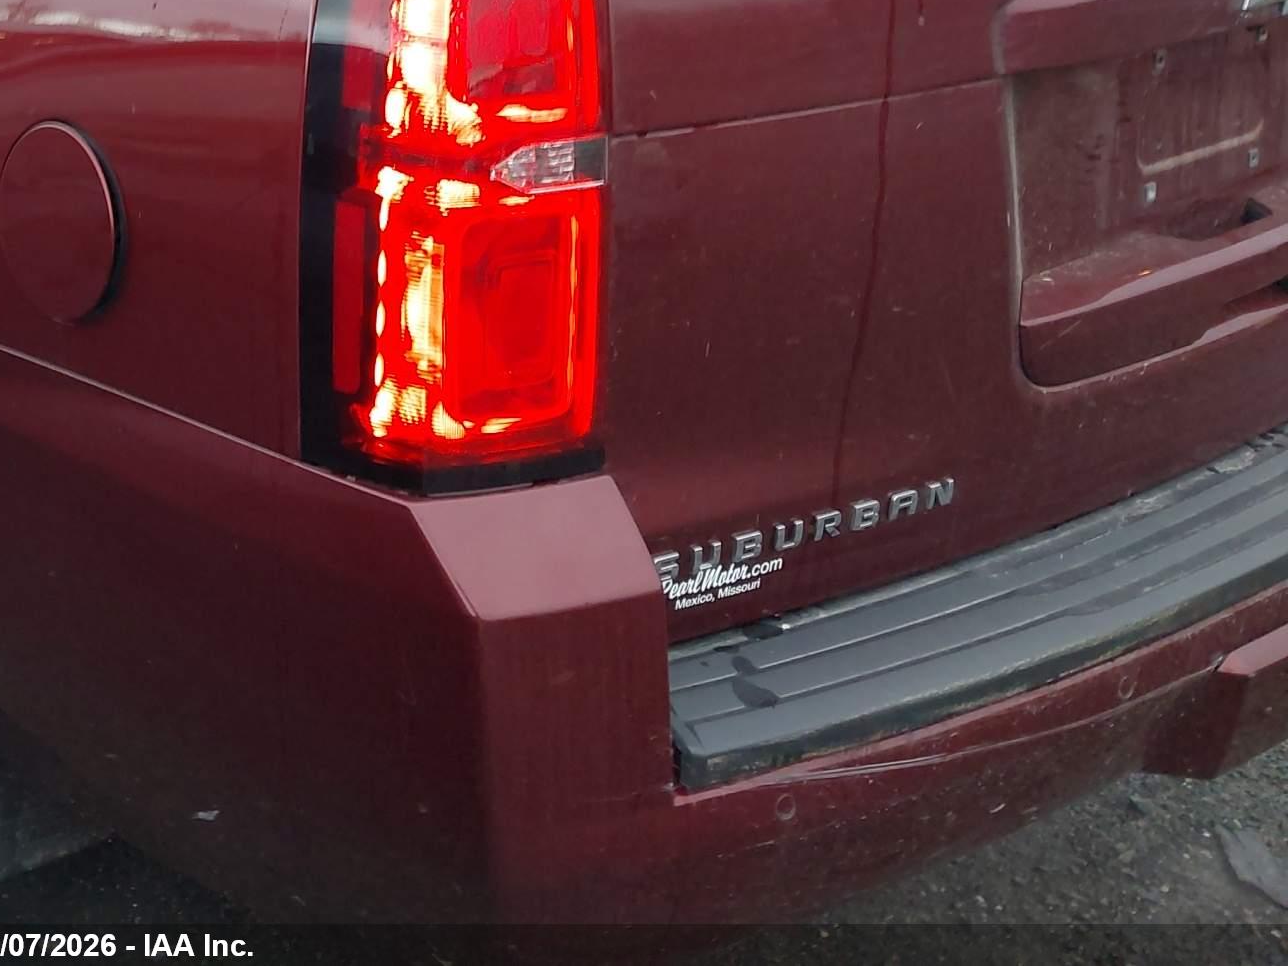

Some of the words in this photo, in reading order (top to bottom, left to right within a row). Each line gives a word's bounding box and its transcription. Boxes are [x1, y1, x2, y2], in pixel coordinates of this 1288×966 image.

[652, 477, 955, 582] SUBURBAN
[674, 591, 716, 611] Mexico,
[717, 577, 761, 599] Missouri
